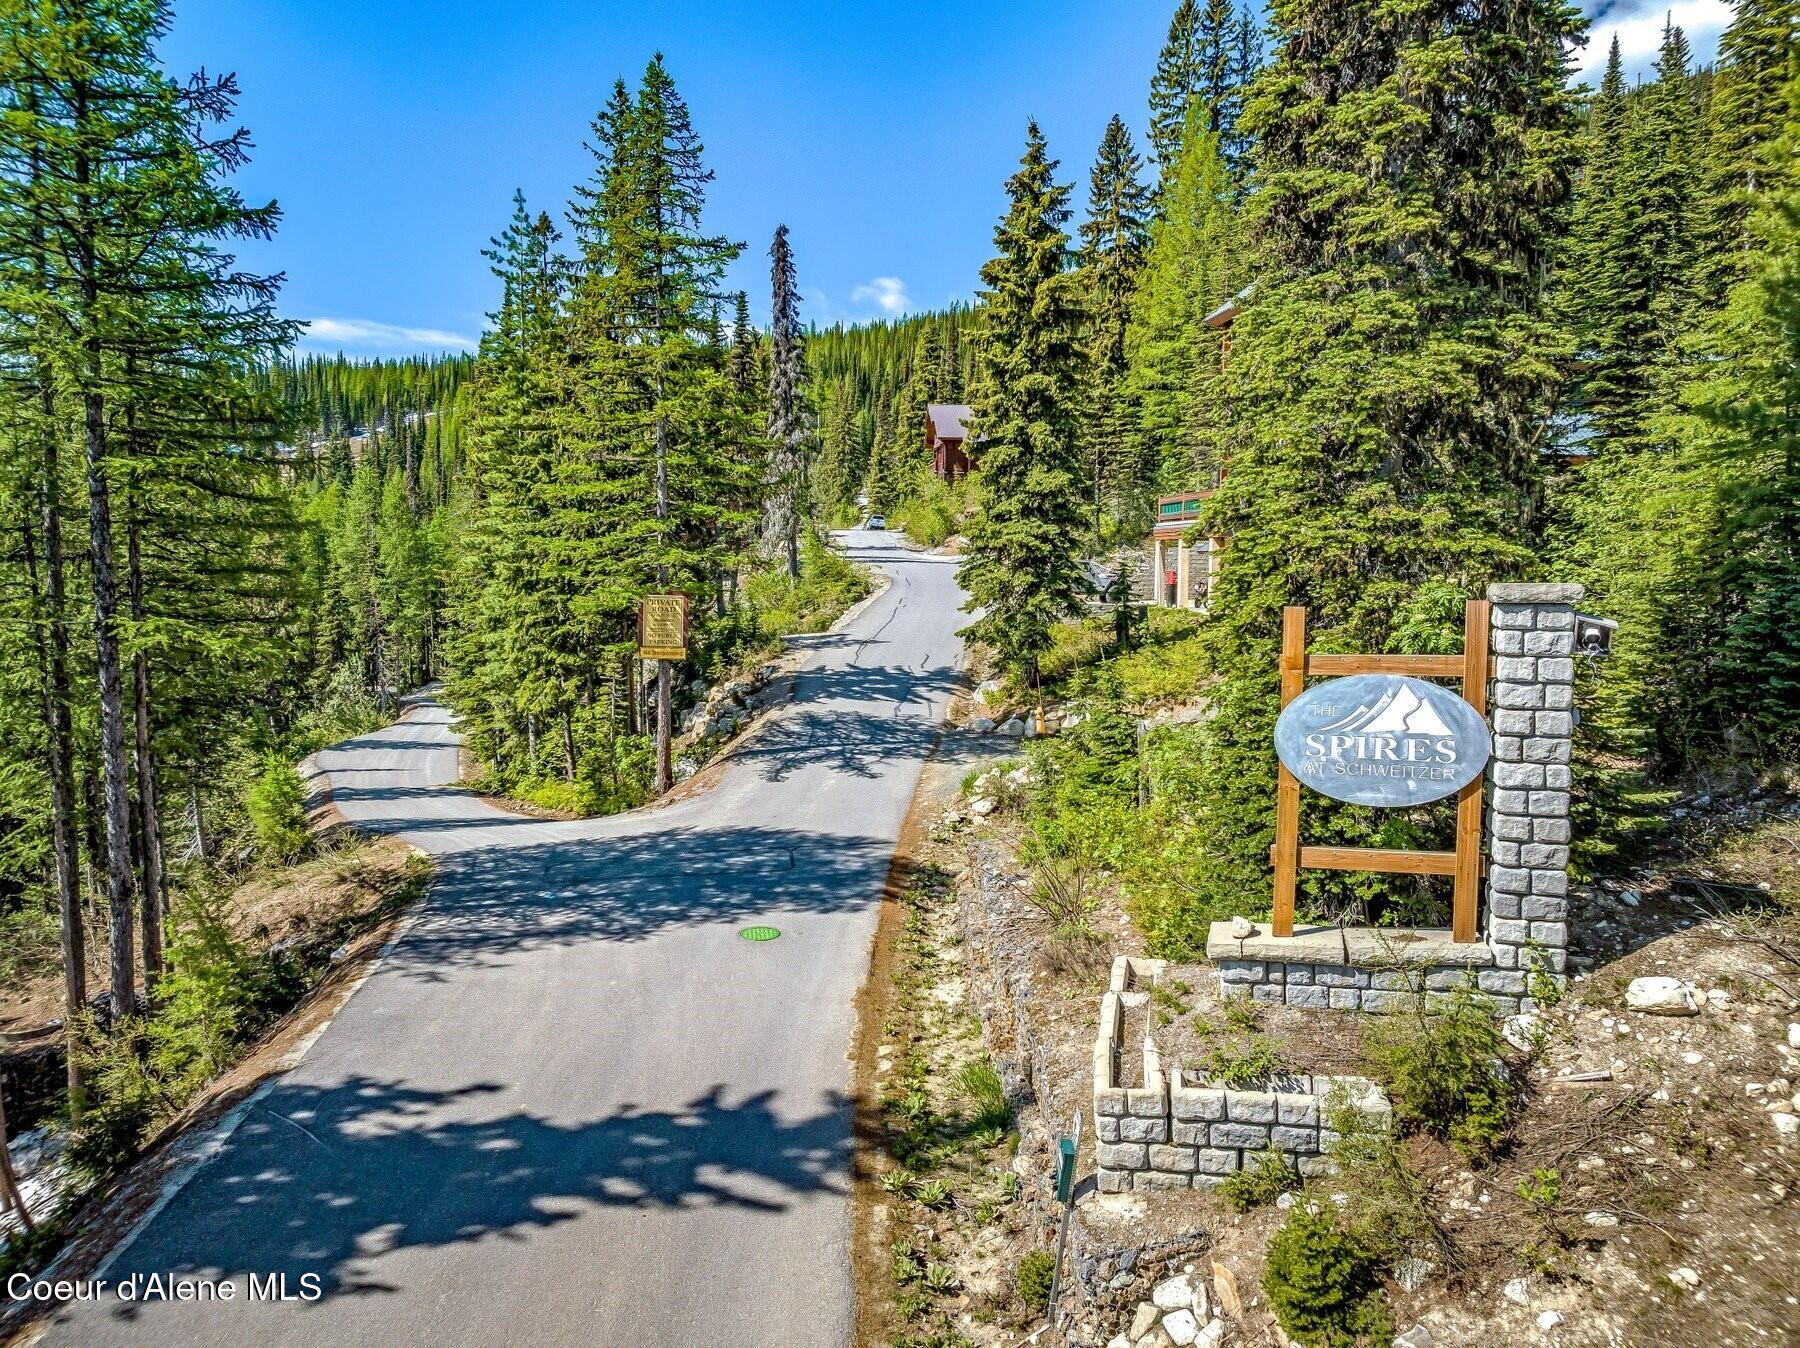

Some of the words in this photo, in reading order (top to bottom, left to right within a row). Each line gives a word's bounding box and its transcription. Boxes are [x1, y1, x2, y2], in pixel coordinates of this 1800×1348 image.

[1311, 704, 1342, 716] THE
[1305, 734, 1457, 764] SPIRES
[1303, 762, 1325, 775] AT
[1335, 763, 1456, 781] SCHWEITZER
